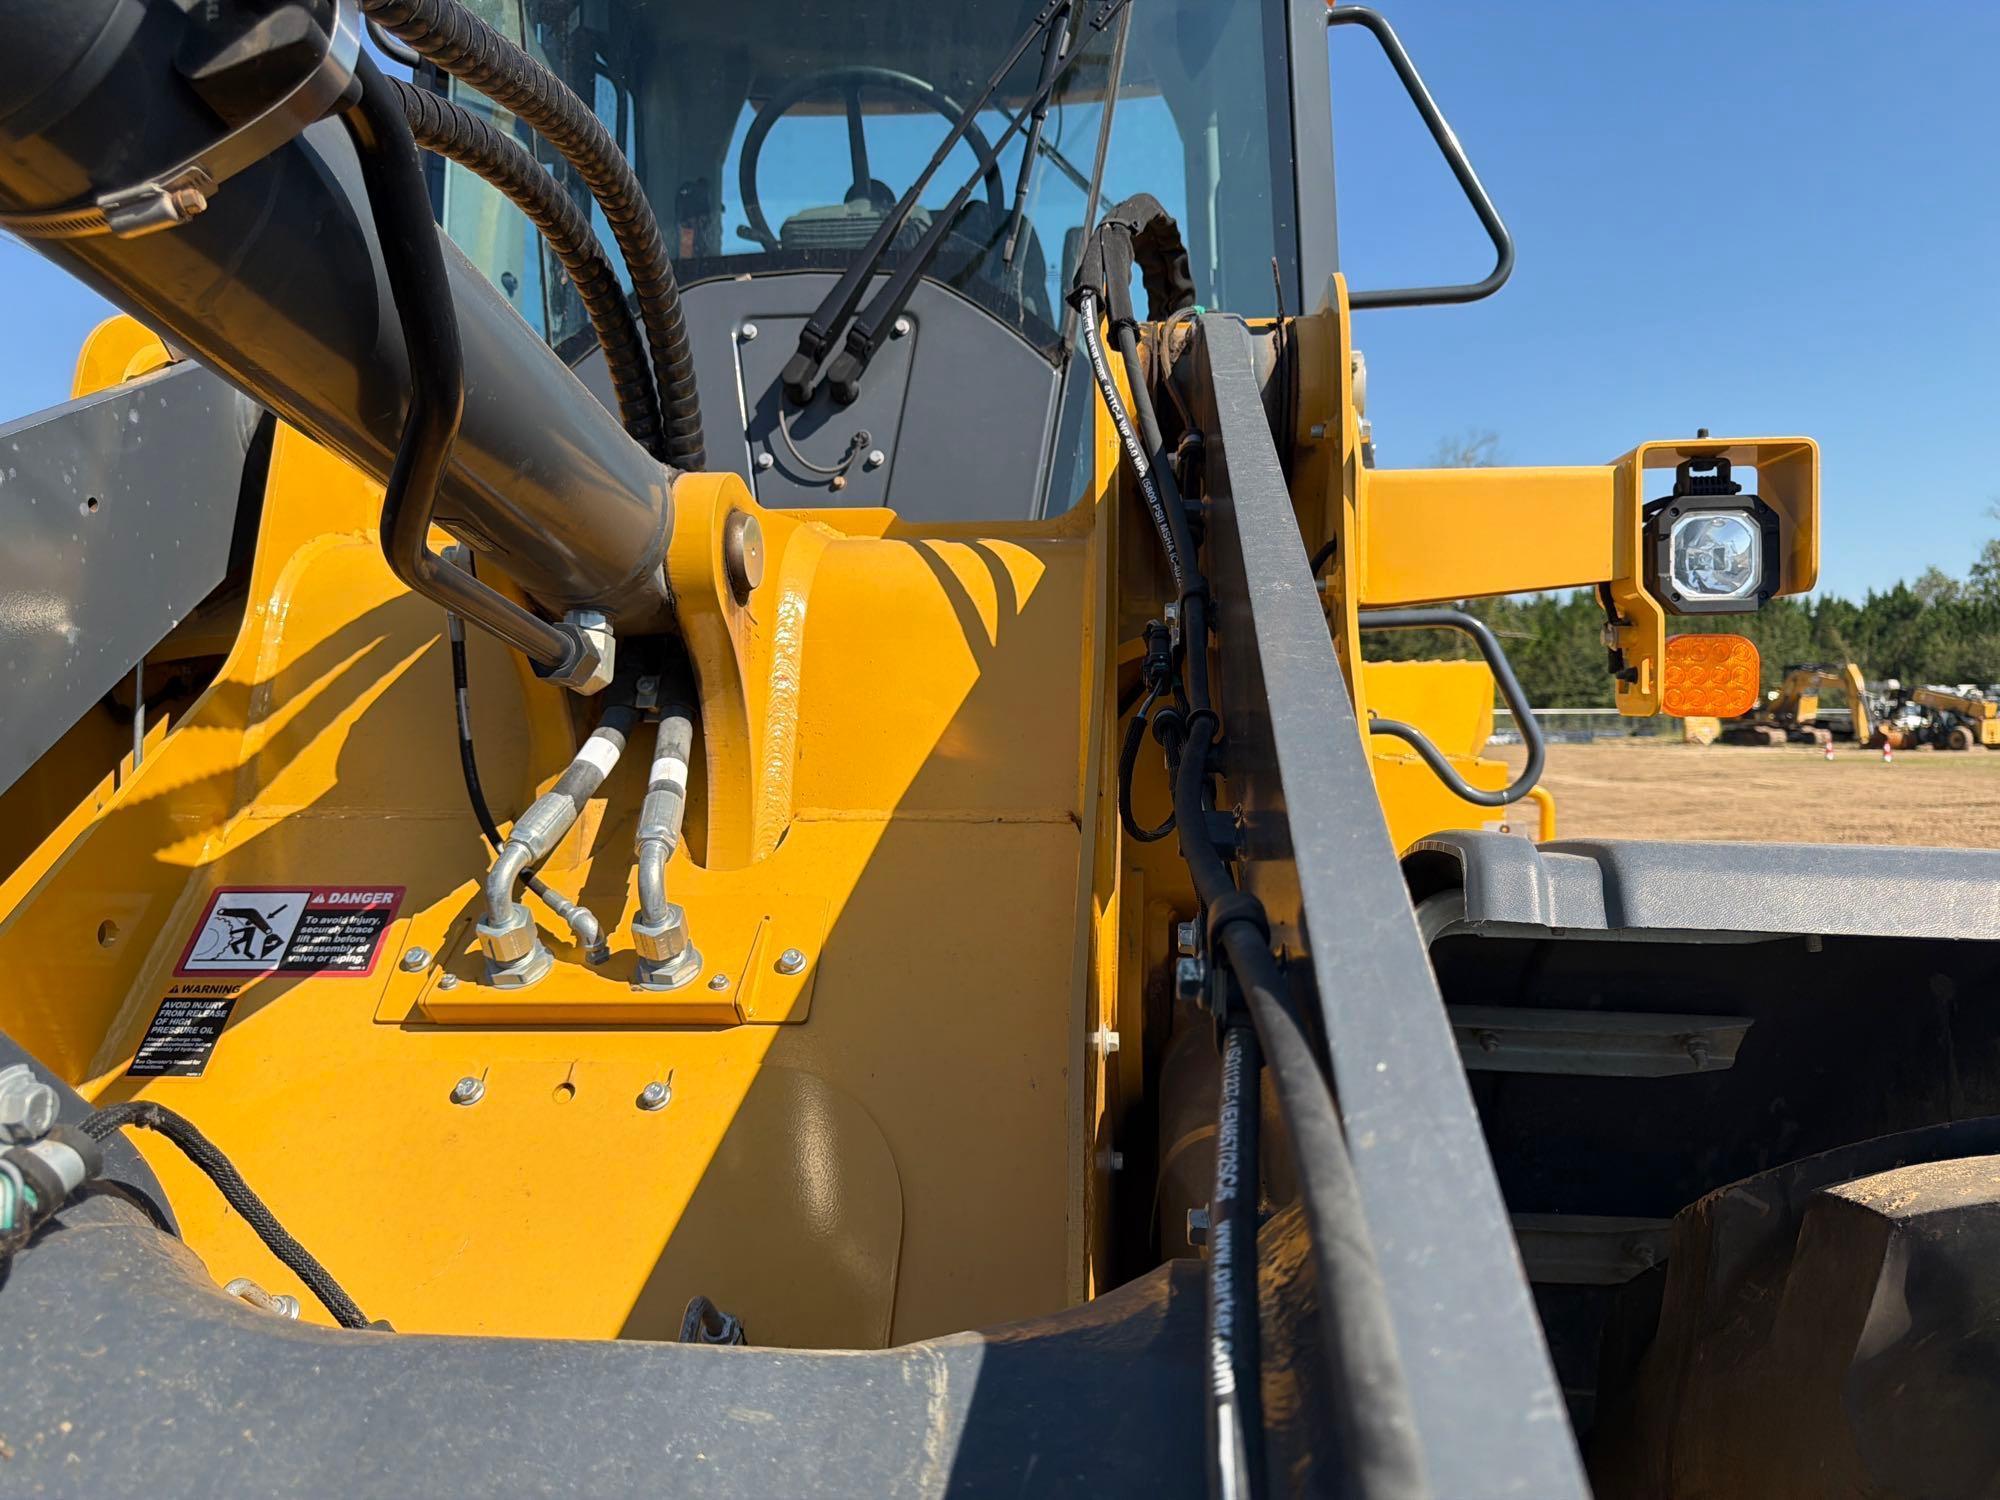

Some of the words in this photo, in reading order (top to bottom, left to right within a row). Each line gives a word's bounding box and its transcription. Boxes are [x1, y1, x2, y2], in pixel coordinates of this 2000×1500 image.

[1104, 385, 1122, 420] 471TC-4
[1119, 420, 1130, 437] WP
[1126, 437, 1138, 457] 40.0
[1134, 457, 1146, 478] MPa
[1142, 478, 1157, 503] (5800
[1153, 503, 1166, 523] PSI)
[1160, 523, 1175, 552] MSHA
[328, 892, 394, 904] DANGER
[305, 916, 319, 925] To
[319, 916, 348, 925] avoid
[349, 916, 381, 925] injury,
[300, 926, 343, 934] securely
[345, 926, 374, 934] brace
[296, 934, 311, 943] lift
[333, 934, 367, 943] before
[292, 944, 355, 954] disassembly
[356, 944, 371, 953] of
[288, 955, 316, 963] valve
[329, 954, 365, 964] piping.
[182, 985, 241, 994] WARNING
[163, 1001, 191, 1009] AVOID
[191, 1001, 225, 1009] INJURY
[159, 1009, 185, 1017] FROM
[186, 1009, 228, 1018] RELEASE
[155, 1018, 168, 1026] OF
[168, 1018, 192, 1026] HIGH
[151, 1026, 199, 1034] PRESSURE
[200, 1026, 214, 1034] OIL
[1211, 1219, 1236, 1396] www.parker.com
